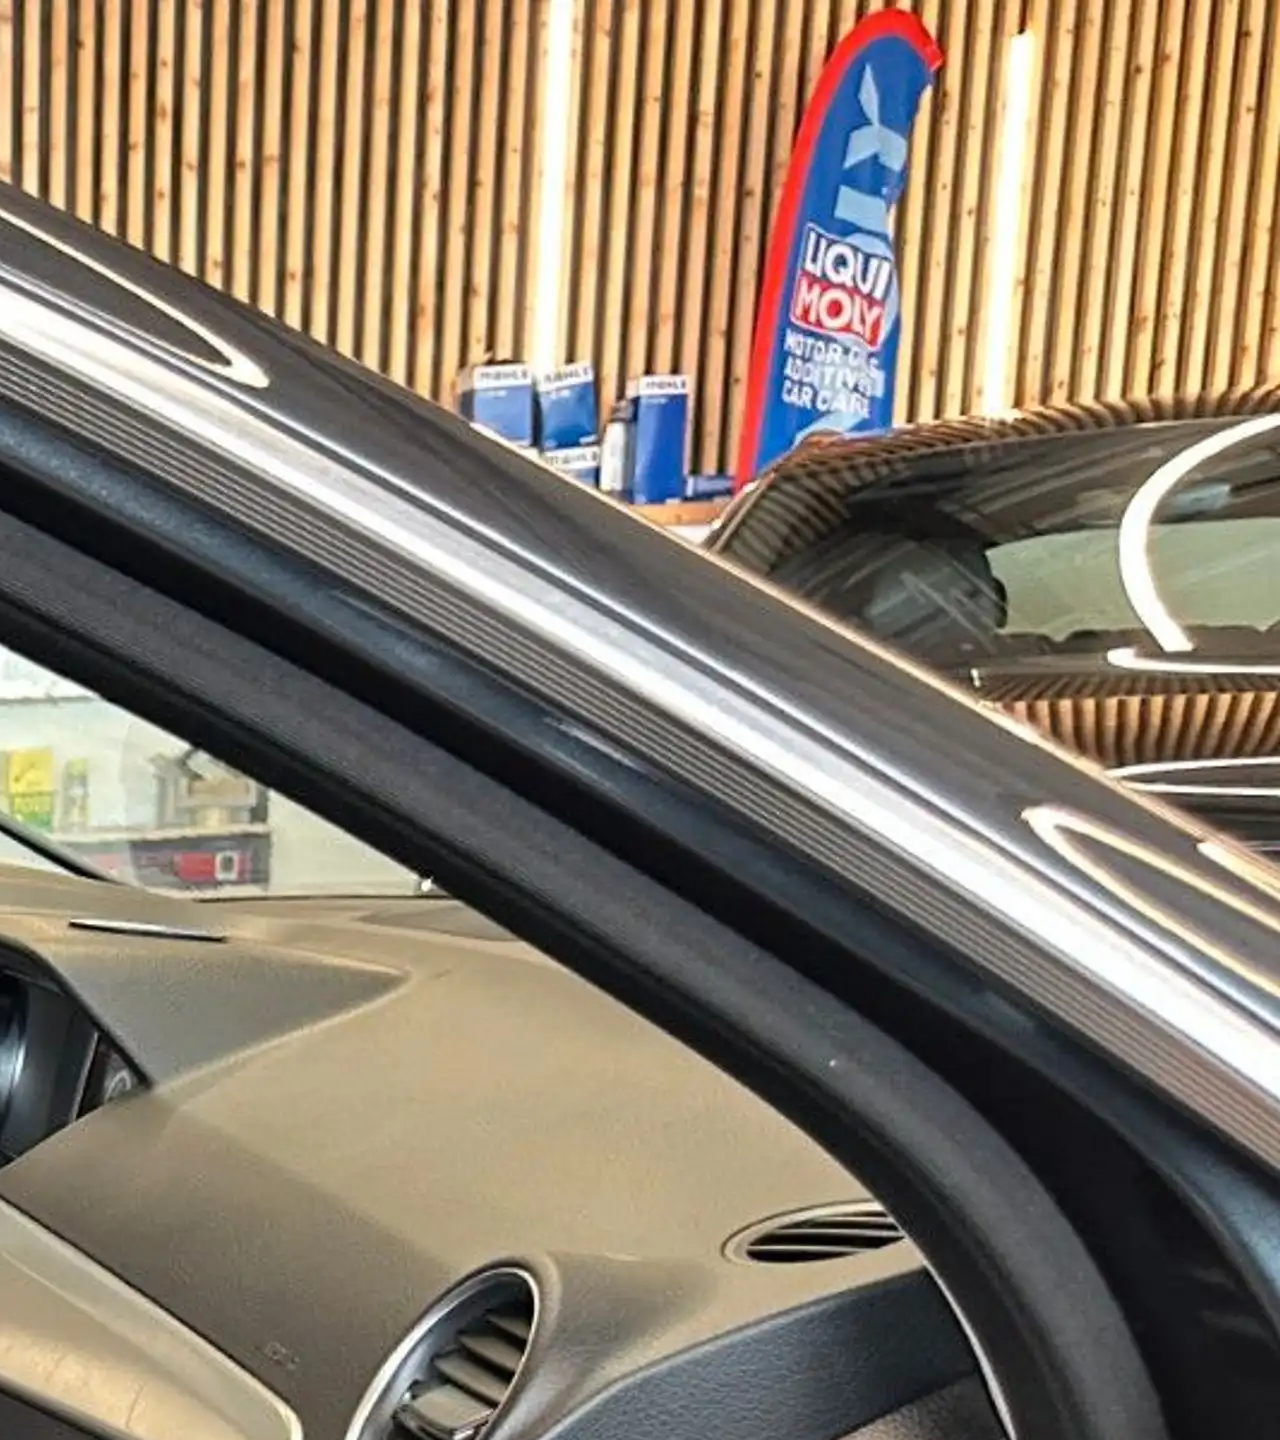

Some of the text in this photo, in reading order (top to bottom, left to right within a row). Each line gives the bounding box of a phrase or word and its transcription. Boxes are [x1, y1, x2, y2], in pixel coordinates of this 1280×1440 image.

[804, 229, 891, 301] LIQUI
[795, 276, 883, 342] MOLY
[783, 328, 842, 365] MOTOR
[782, 379, 813, 410] CAR
